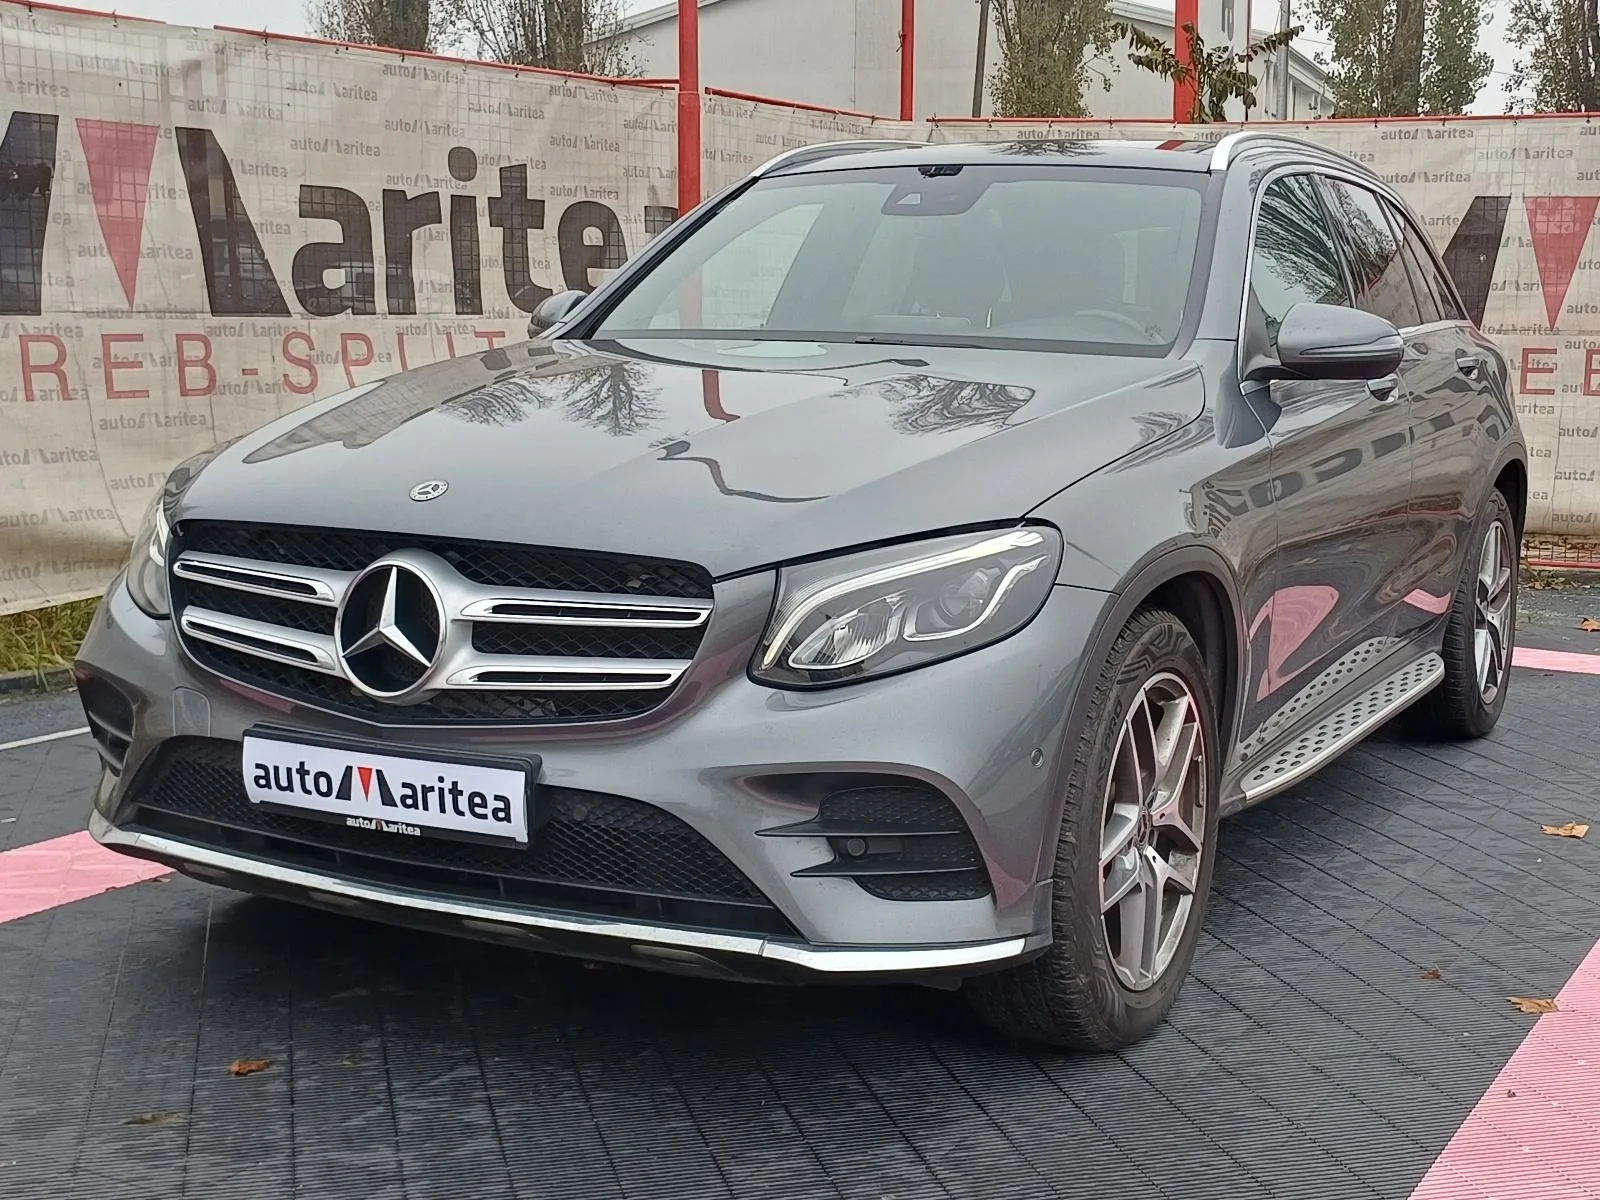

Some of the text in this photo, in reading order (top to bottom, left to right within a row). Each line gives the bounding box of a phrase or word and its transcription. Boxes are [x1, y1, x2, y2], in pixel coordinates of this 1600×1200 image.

[385, 119, 466, 138] autoMaritea
[1381, 128, 1474, 140] autoMaritea
[290, 138, 381, 158] autoMaritea
[549, 135, 621, 153] autoMaritea
[1478, 147, 1574, 161] autoMaritea
[549, 185, 619, 201] autoMaritea
[99, 411, 208, 430] autoMaritea
[253, 761, 514, 824] autoMaritea
[346, 817, 421, 837] autoMaritea
